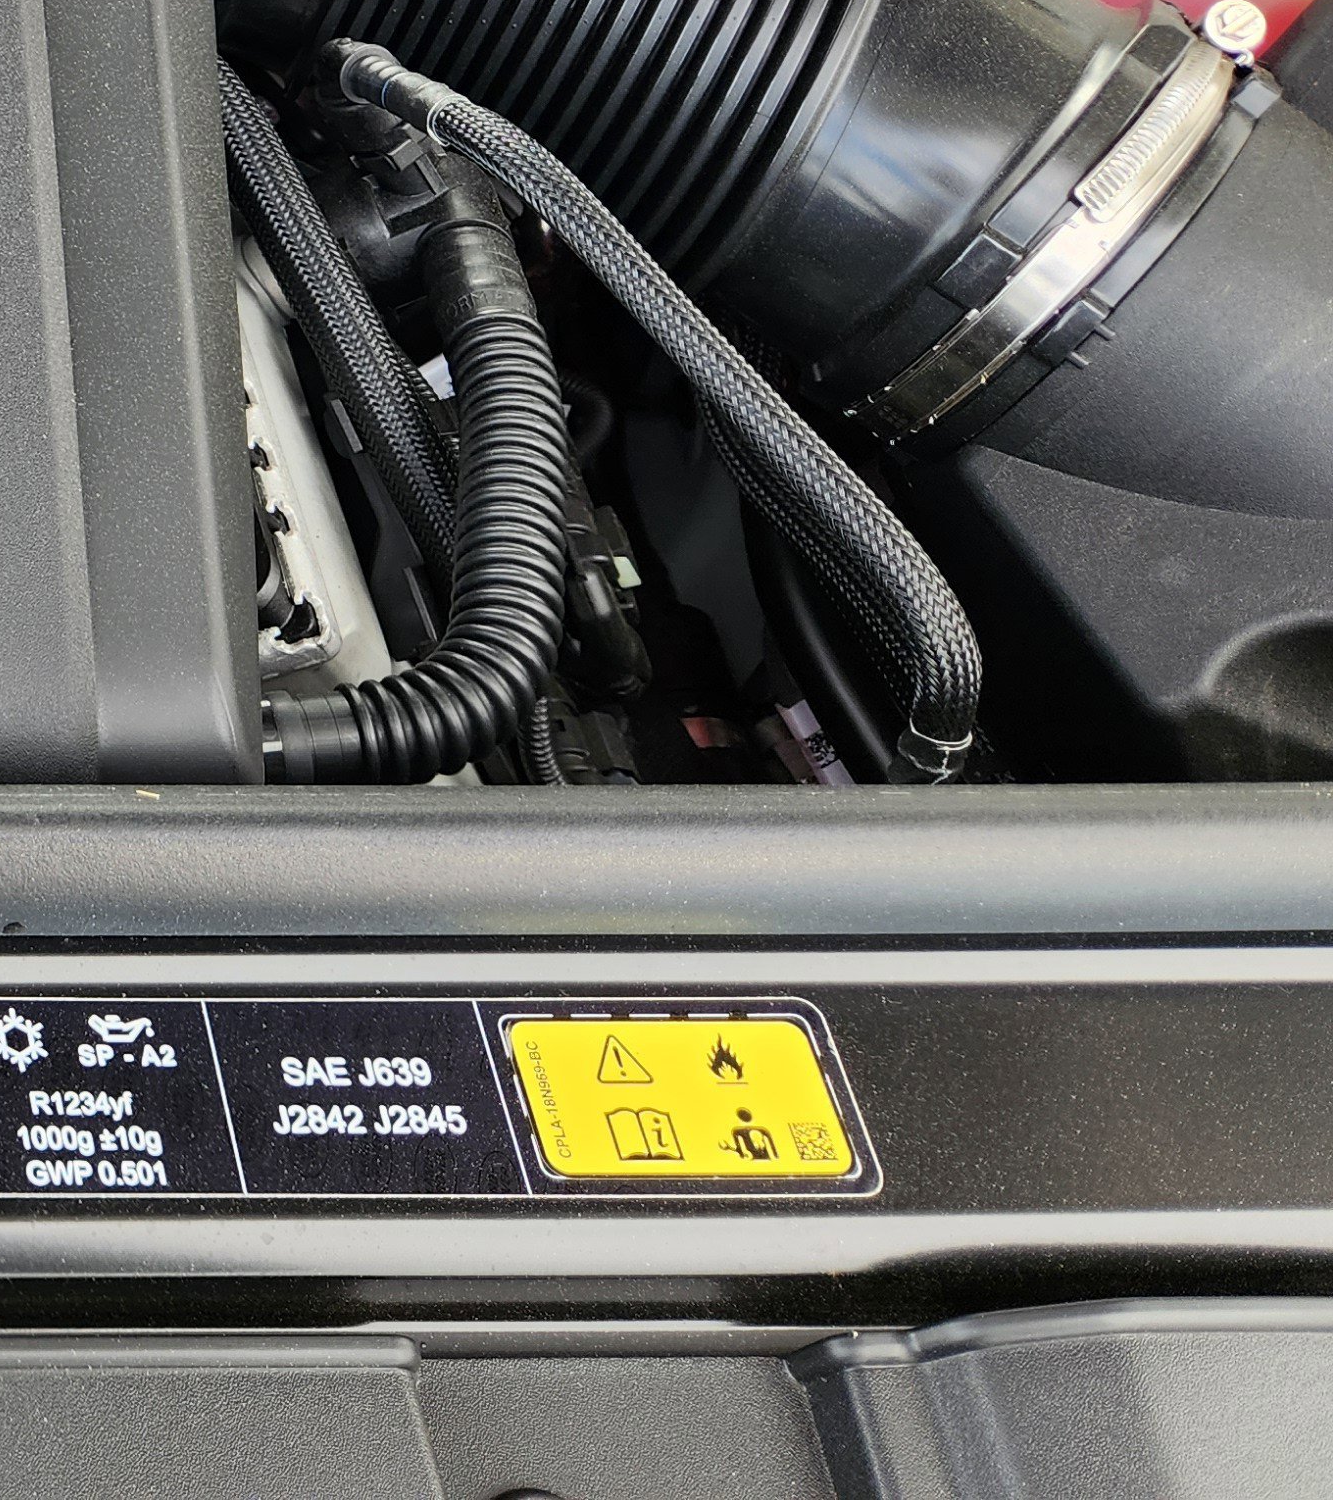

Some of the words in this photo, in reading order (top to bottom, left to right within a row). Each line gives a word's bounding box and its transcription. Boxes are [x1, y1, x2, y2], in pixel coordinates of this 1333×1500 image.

[77, 1044, 115, 1068] SP
[141, 1044, 178, 1068] A2
[282, 1057, 351, 1087] SAE
[357, 1057, 433, 1087] J639
[29, 1091, 133, 1121] R1234yf
[525, 1040, 572, 1159] CPLA-18N969-BC
[273, 1105, 367, 1136] J2842
[374, 1105, 467, 1136] J2845
[17, 1126, 95, 1156] 1000g
[100, 1126, 164, 1157] ±10g
[26, 1160, 93, 1186] GWP
[97, 1161, 169, 1187] 0.501
